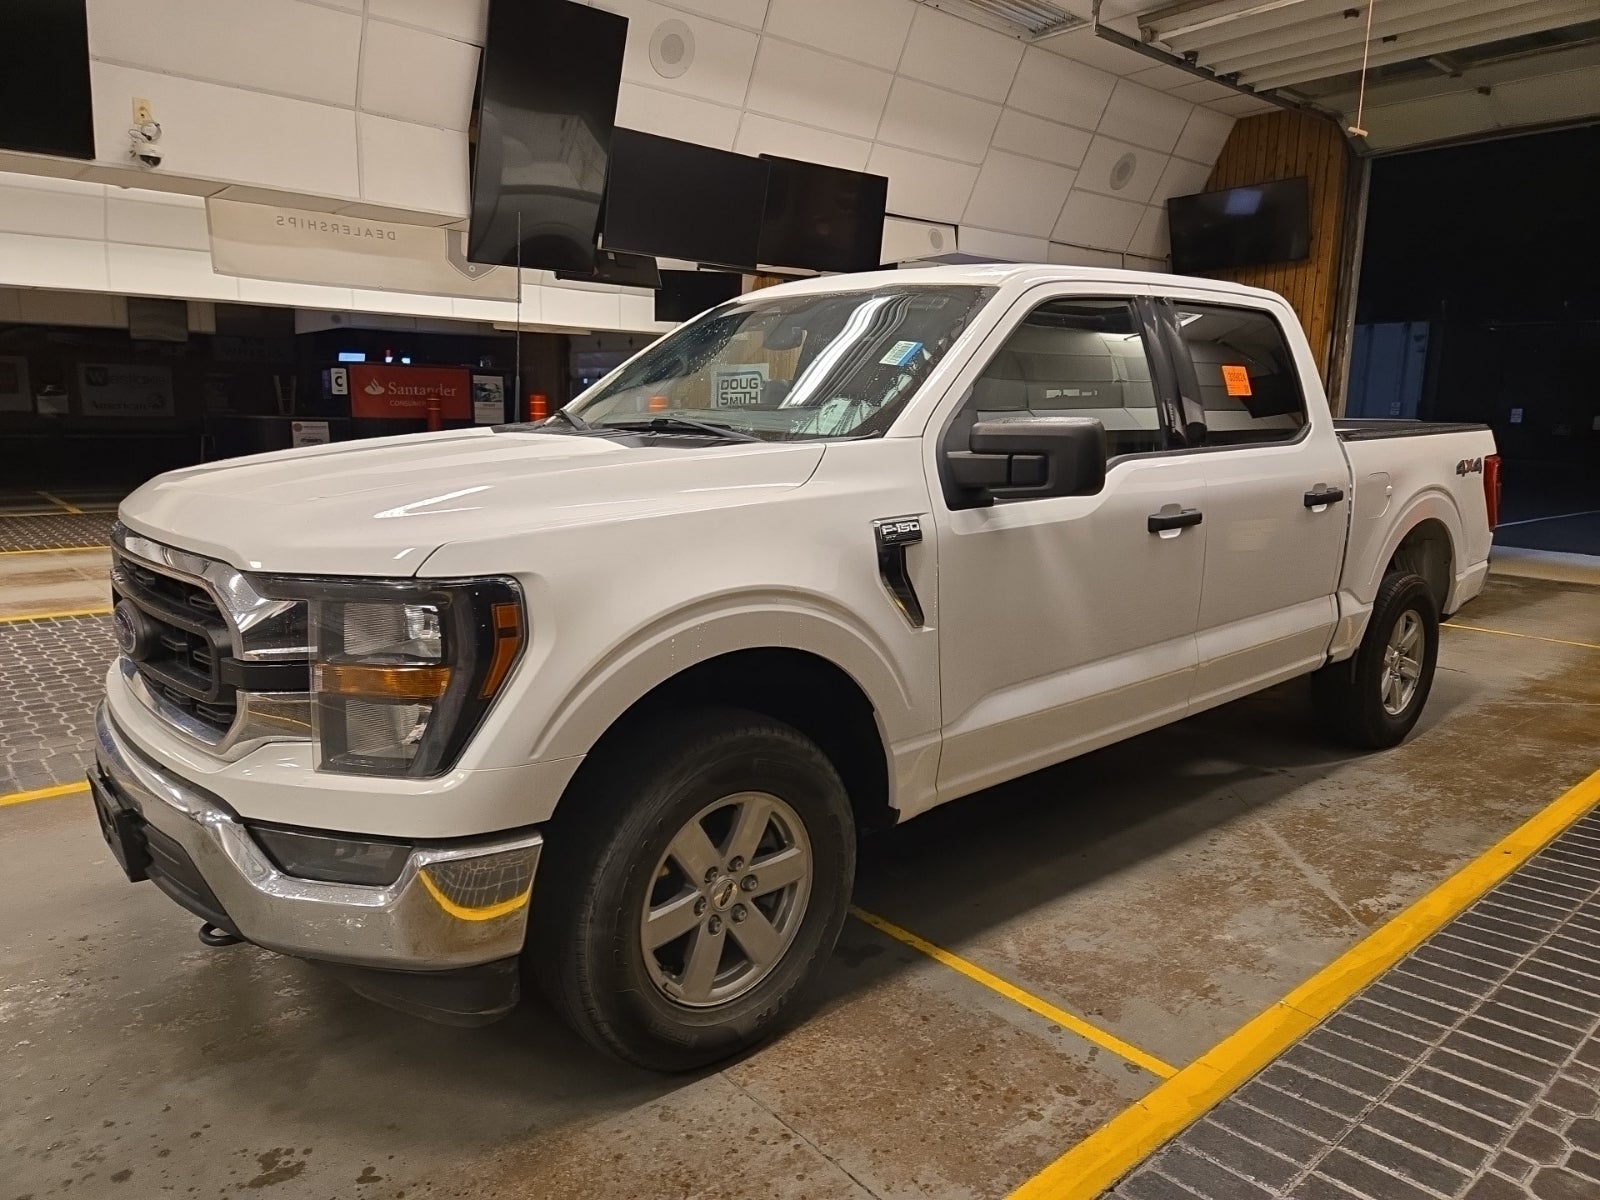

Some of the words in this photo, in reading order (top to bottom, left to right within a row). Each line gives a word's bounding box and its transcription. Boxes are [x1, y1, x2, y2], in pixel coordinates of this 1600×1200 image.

[334, 375, 343, 388] C
[721, 377, 759, 390] DOUG
[388, 381, 457, 397] Santander
[720, 391, 758, 405] SMITH
[881, 522, 920, 535] F-150
